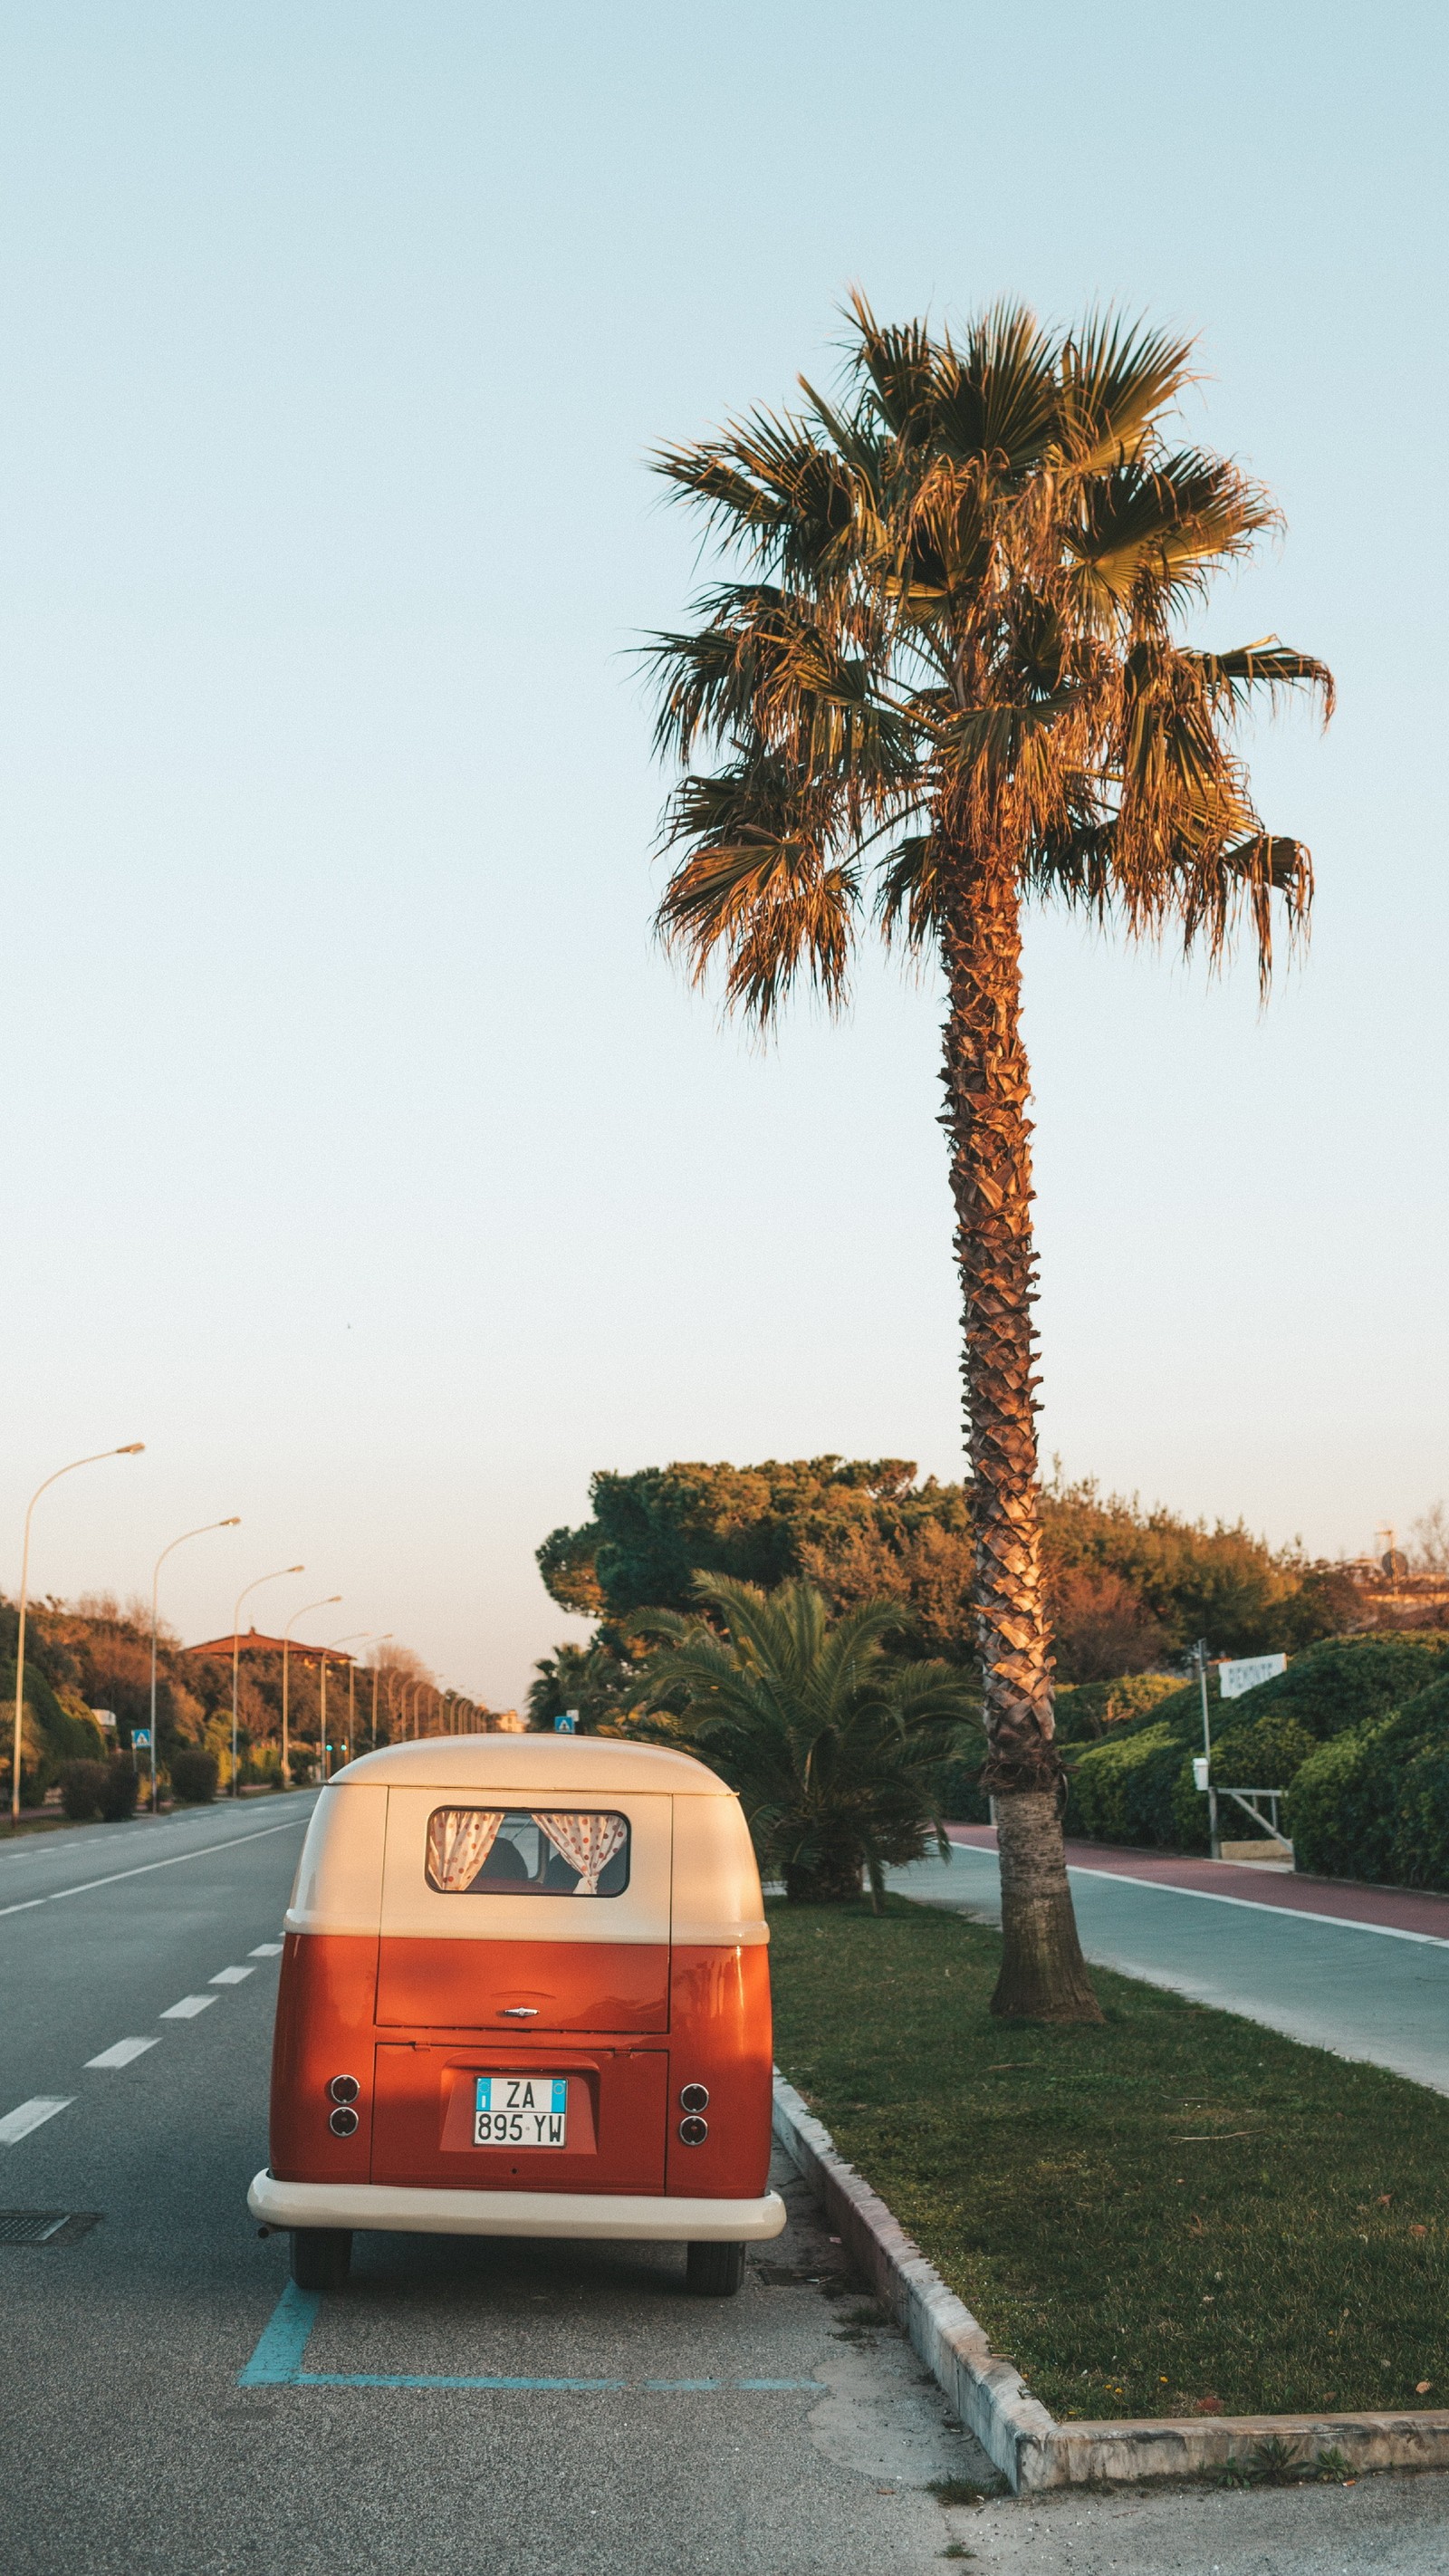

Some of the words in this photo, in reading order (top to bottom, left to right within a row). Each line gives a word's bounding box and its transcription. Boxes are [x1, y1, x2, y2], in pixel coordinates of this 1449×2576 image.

[506, 2081, 534, 2108] ZA
[478, 2113, 523, 2140] 895
[533, 2115, 561, 2142] YW
